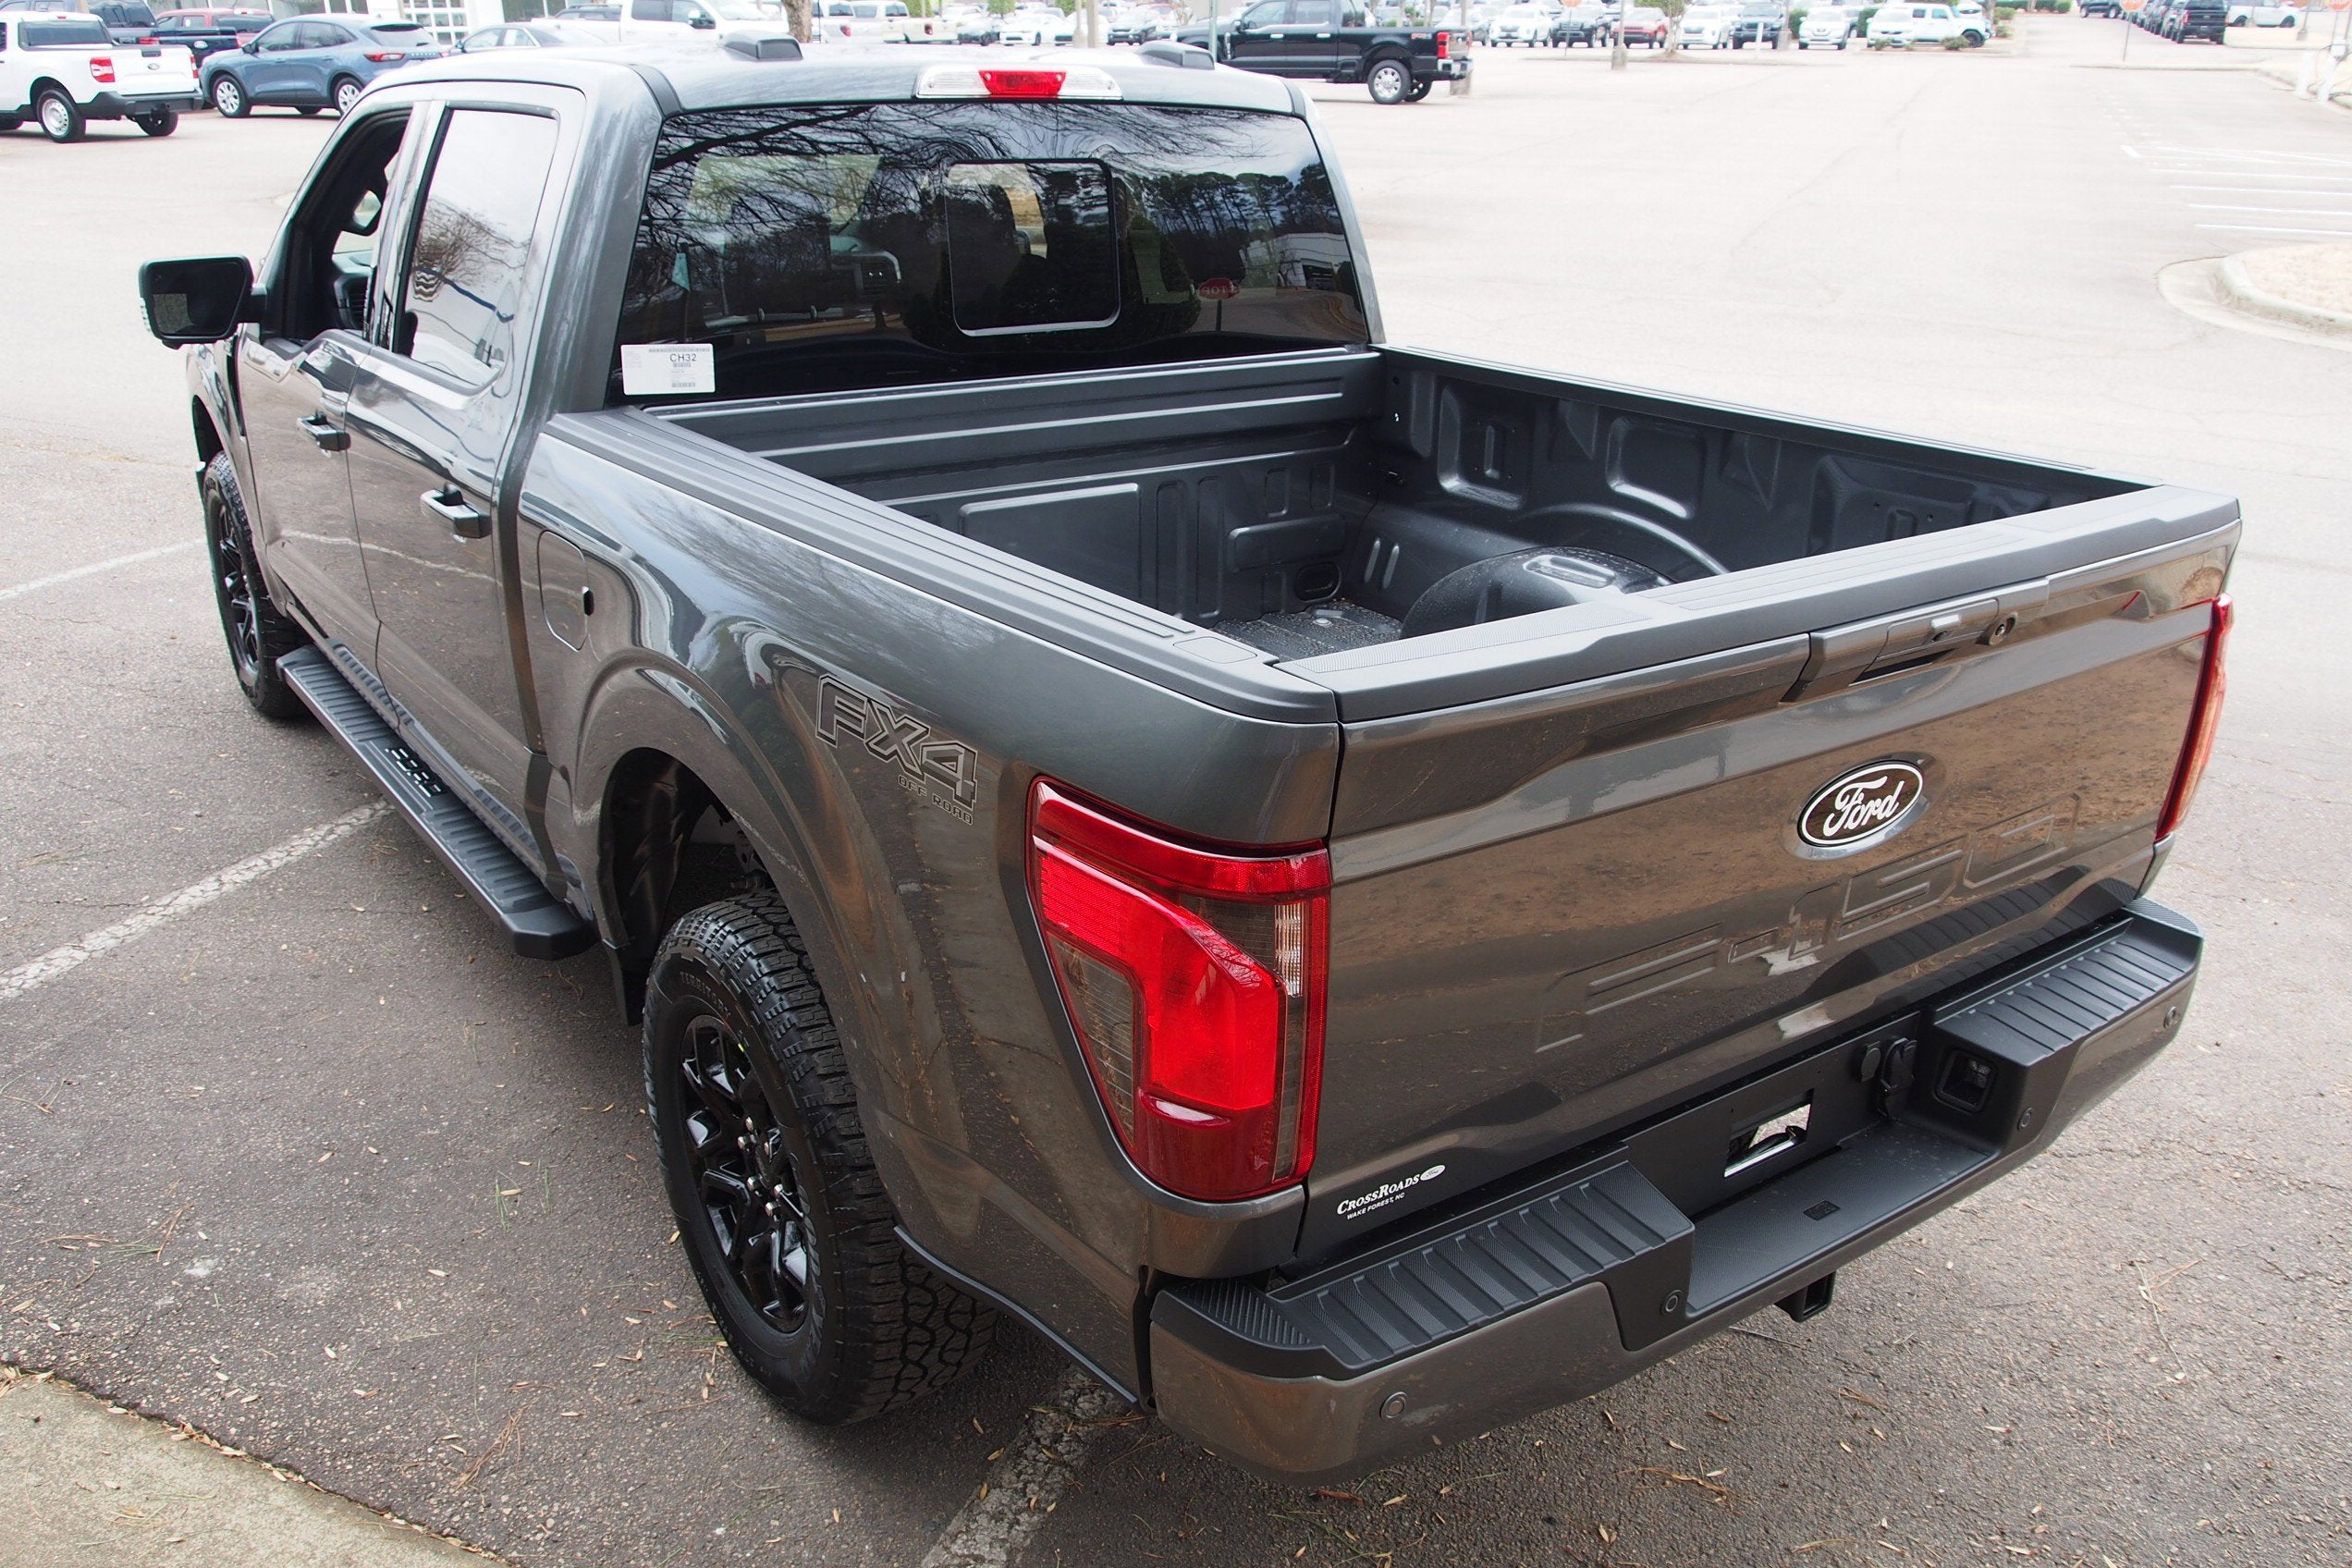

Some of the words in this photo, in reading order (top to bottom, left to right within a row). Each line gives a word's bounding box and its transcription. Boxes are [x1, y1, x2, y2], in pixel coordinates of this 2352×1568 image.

[669, 353, 697, 363] CH32
[815, 673, 978, 812] FX4
[898, 774, 927, 797] OFF
[932, 792, 974, 826] ROAD
[1822, 775, 1905, 838] Ford
[1536, 792, 2082, 1054] F-150
[1347, 1206, 1366, 1220] WAKE
[1367, 1196, 1394, 1213] FOREST,
[1394, 1192, 1405, 1201] NC
